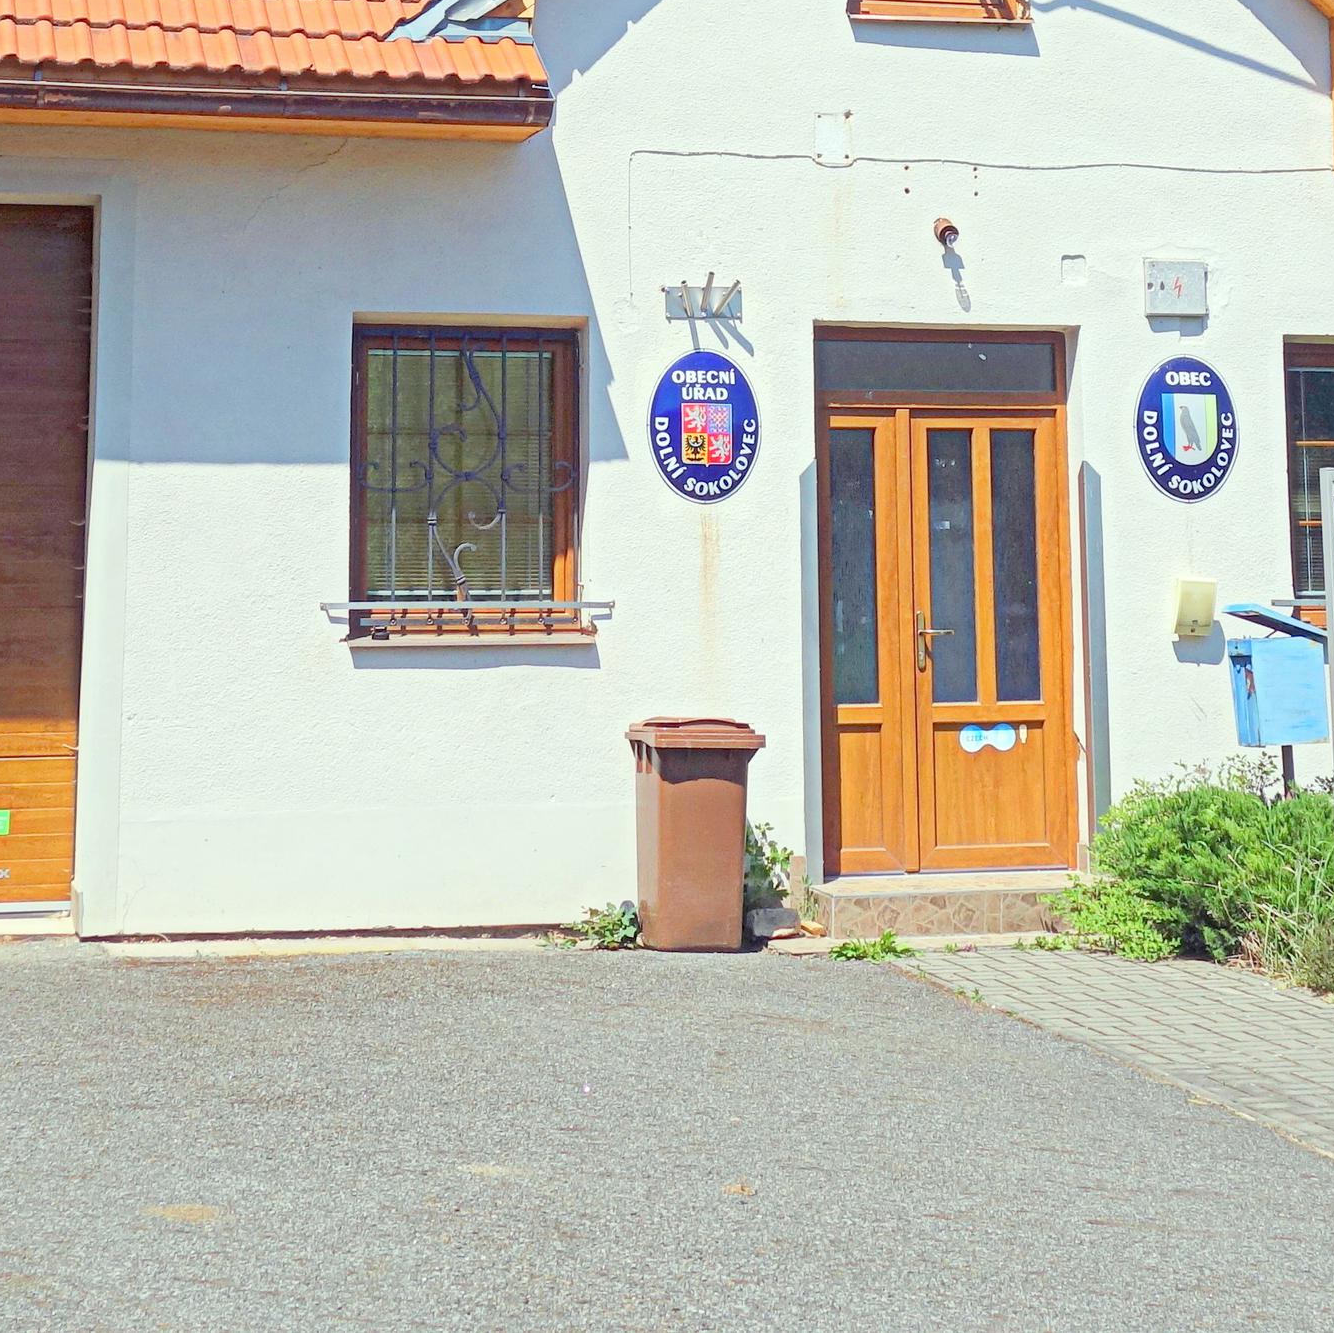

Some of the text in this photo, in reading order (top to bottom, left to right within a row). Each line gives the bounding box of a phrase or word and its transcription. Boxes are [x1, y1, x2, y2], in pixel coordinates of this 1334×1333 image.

[671, 369, 736, 385] OBECNÍ
[1165, 371, 1212, 386] OBEC
[681, 384, 728, 400] ÚŘAD
[655, 417, 756, 496] DOLNÍ SOKOLOVEC
[1143, 410, 1234, 494] DOLNÍ SOKOLOVEC
